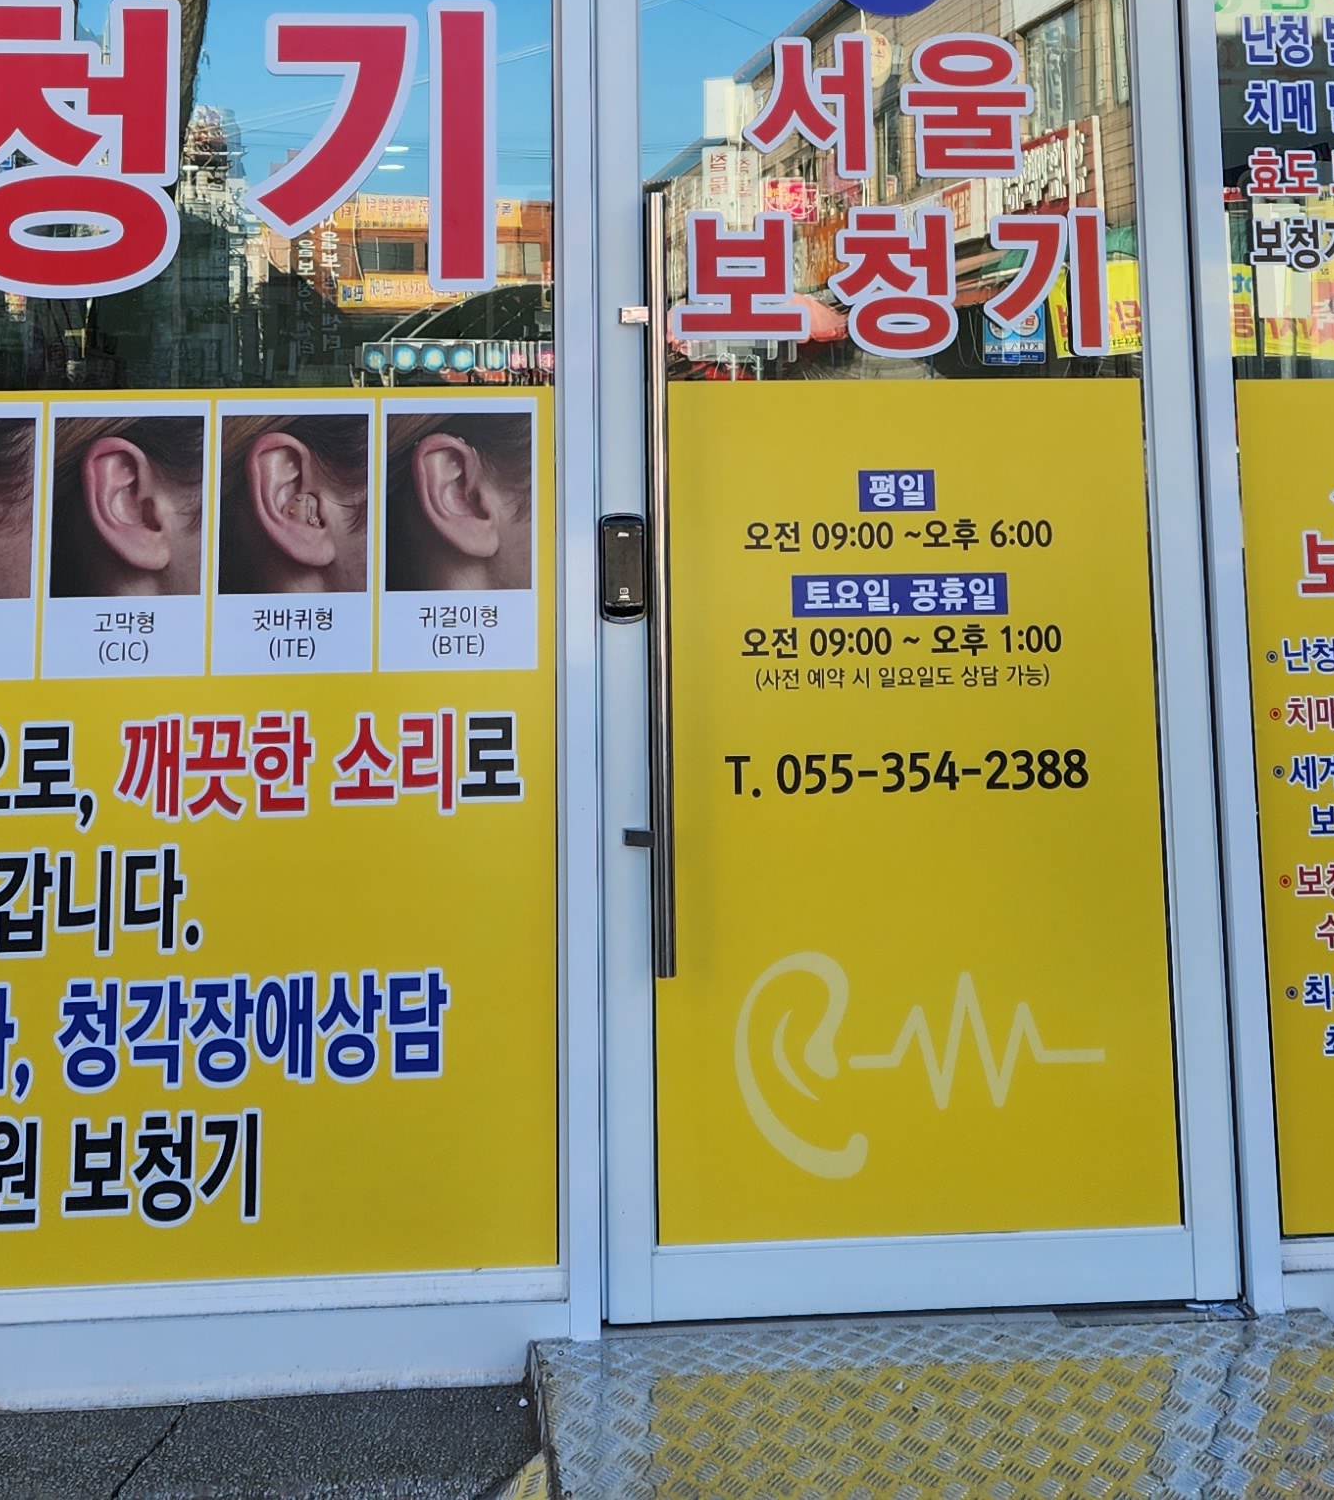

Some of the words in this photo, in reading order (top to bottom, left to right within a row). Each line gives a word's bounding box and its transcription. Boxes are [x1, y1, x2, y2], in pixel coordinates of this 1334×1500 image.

[1243, 13, 1312, 67] 난청
[746, 35, 1030, 175] 서울
[1244, 81, 1316, 133] 치매
[1248, 147, 1319, 198] 효도
[677, 209, 1107, 354] 보청기
[869, 474, 925, 508] 평일
[744, 521, 801, 552] 오전
[812, 520, 894, 552] 09:00
[990, 518, 1053, 550] 6:00
[804, 579, 900, 614] 토요일,
[909, 578, 996, 612] 공휴일
[93, 610, 155, 635] 고막형
[251, 607, 334, 632] 귓바퀴형
[418, 604, 499, 629] 귀걸이형
[98, 639, 149, 664] (CIC)
[269, 636, 316, 661] (ITE)
[431, 633, 485, 658] (BTE)
[741, 628, 798, 659] 오전
[810, 626, 892, 658] 09:00
[931, 623, 988, 655] 오후
[1000, 624, 1062, 654] 1:00
[755, 666, 799, 692] (사전
[807, 666, 845, 690] 예약
[852, 666, 871, 689] 시
[878, 665, 954, 689] 일요일도
[961, 665, 998, 688] 상담
[1006, 664, 1050, 688] 가능)
[116, 713, 315, 825] 깨끗한
[329, 711, 521, 817] 소리로
[725, 754, 761, 798] T.
[776, 748, 1089, 796] 055-354-2388
[55, 967, 449, 1094] 청각장애상담
[61, 1107, 262, 1229] 보청기
